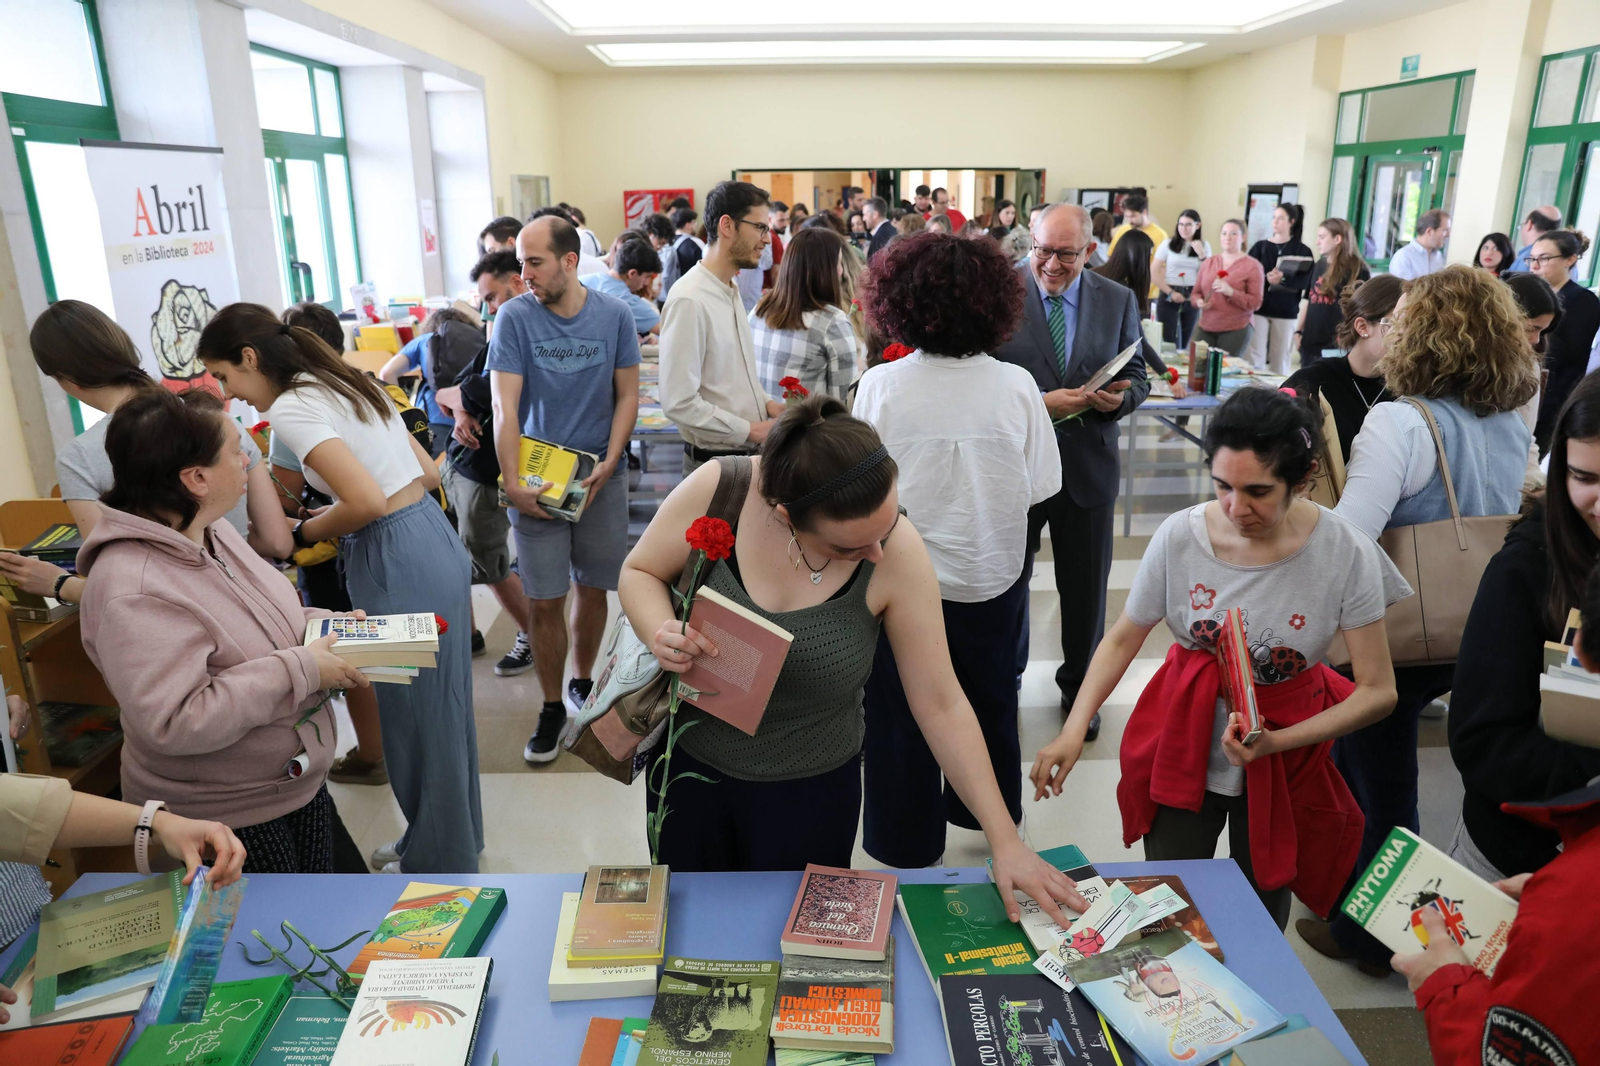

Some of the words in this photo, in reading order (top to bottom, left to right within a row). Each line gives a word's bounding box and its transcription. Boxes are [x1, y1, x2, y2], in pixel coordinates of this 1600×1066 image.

[133, 184, 210, 237] Abril
[122, 254, 134, 265] en
[137, 250, 144, 262] la
[146, 246, 188, 261] Biblioteca
[193, 241, 215, 255] 2024
[535, 346, 574, 361] Indigo
[576, 345, 599, 359] Dye
[1346, 838, 1408, 918] PHYTOMA
[824, 900, 855, 912] Suelo
[146, 916, 160, 924] EN
[827, 912, 846, 921] del
[56, 918, 143, 948] AGRICULTURA
[88, 926, 161, 949] DIVERSIDAD
[109, 921, 160, 938] VEGETAL
[991, 952, 1031, 968] cálculo
[1473, 950, 1488, 969] ARIO
[602, 966, 646, 975] SISTEMAS
[807, 985, 882, 1000] DOMESTICI
[780, 996, 840, 1011] ANIMALI
[843, 1000, 881, 1013] DEGLI
[779, 1008, 880, 1026] ZOOGNOSTICA
[966, 987, 993, 1042] PERGOLAS
[775, 1022, 834, 1035] Tortorelli
[1193, 1016, 1221, 1030] Relato
[837, 1026, 880, 1037] Nicola
[1072, 1027, 1087, 1050] control
